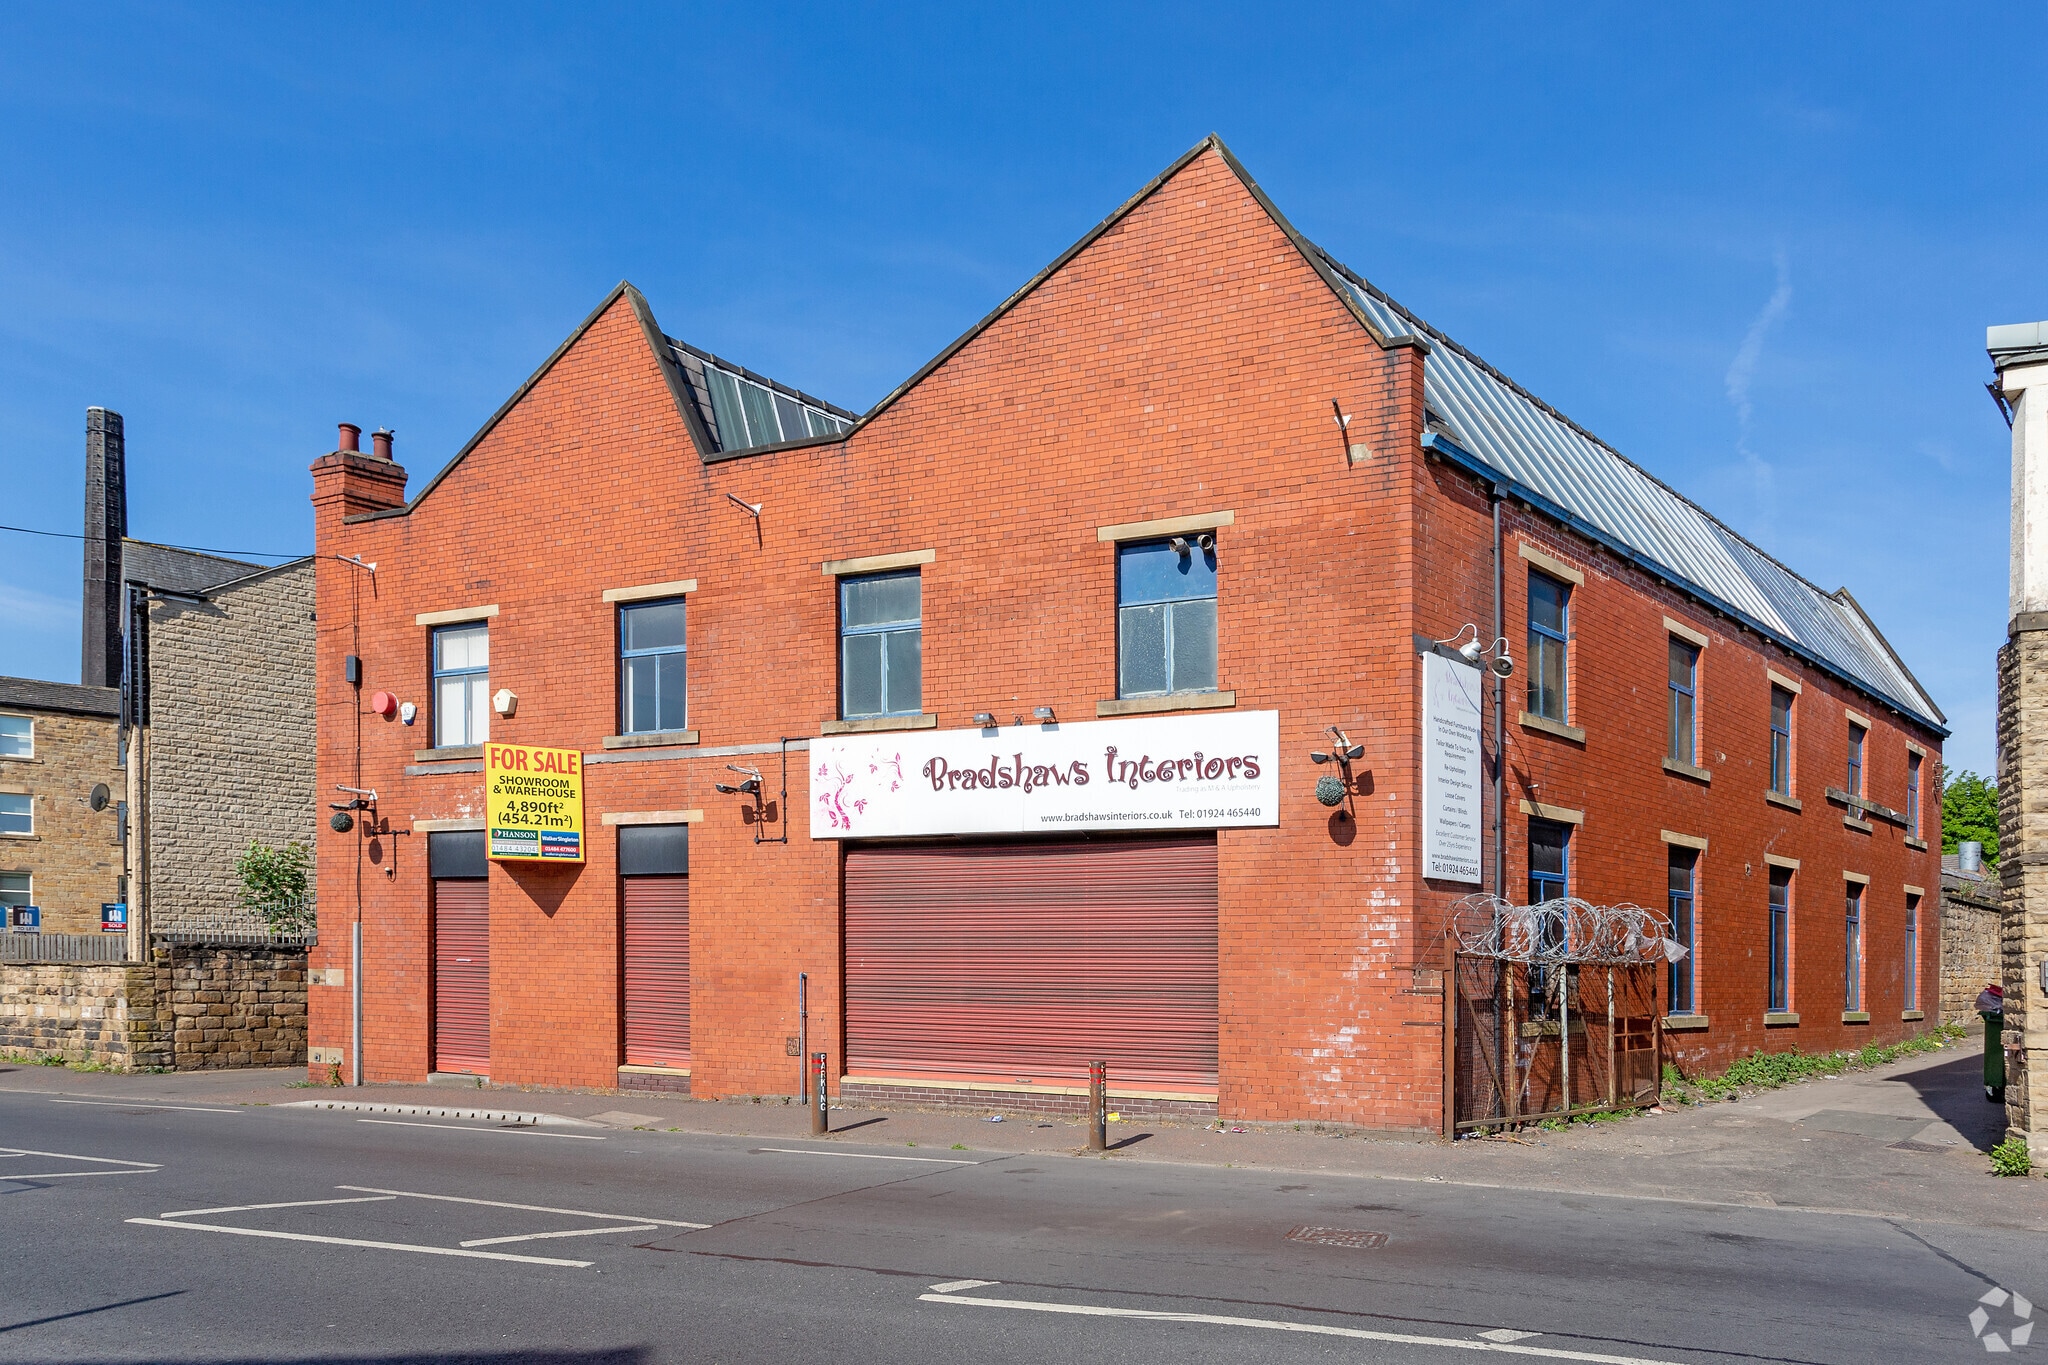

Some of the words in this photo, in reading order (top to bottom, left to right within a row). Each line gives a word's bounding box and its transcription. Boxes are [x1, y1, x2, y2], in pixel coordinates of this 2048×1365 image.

[1433, 715, 1453, 727] Handcrafted
[1435, 738, 1445, 747] Tailor
[1456, 731, 1472, 742] Workshop
[490, 747, 529, 771] FOR
[533, 750, 578, 775] SALE
[1444, 750, 1467, 762] Requirements
[923, 752, 1090, 794] Bradshaws
[1103, 745, 1261, 790] Interiors
[499, 775, 570, 789] SHOWROOM
[1438, 776, 1449, 785] Interior
[1450, 778, 1460, 789] Design
[1461, 781, 1473, 790] Service
[493, 785, 502, 794] &
[504, 785, 576, 799] WAREHOUSE
[1176, 786, 1199, 794] Trading
[1227, 783, 1261, 793] Upholstery
[1444, 791, 1454, 800] Loose
[1455, 793, 1466, 801] Covers
[1040, 810, 1173, 823] www.bradshawsinteriors.co.uk
[1179, 809, 1195, 819] Tel:
[1196, 808, 1225, 819] 01924
[1226, 807, 1261, 818] 465440
[1442, 804, 1456, 813] Curtains
[1458, 807, 1468, 816] Blinds
[1439, 818, 1457, 828] Wallpapers
[1459, 821, 1471, 830] Carpets
[502, 830, 537, 839] HANSON
[1435, 829, 1450, 838] Excellent
[1432, 861, 1442, 873] Tel:
[1442, 862, 1459, 875] 01924
[1459, 865, 1479, 877] 465440
